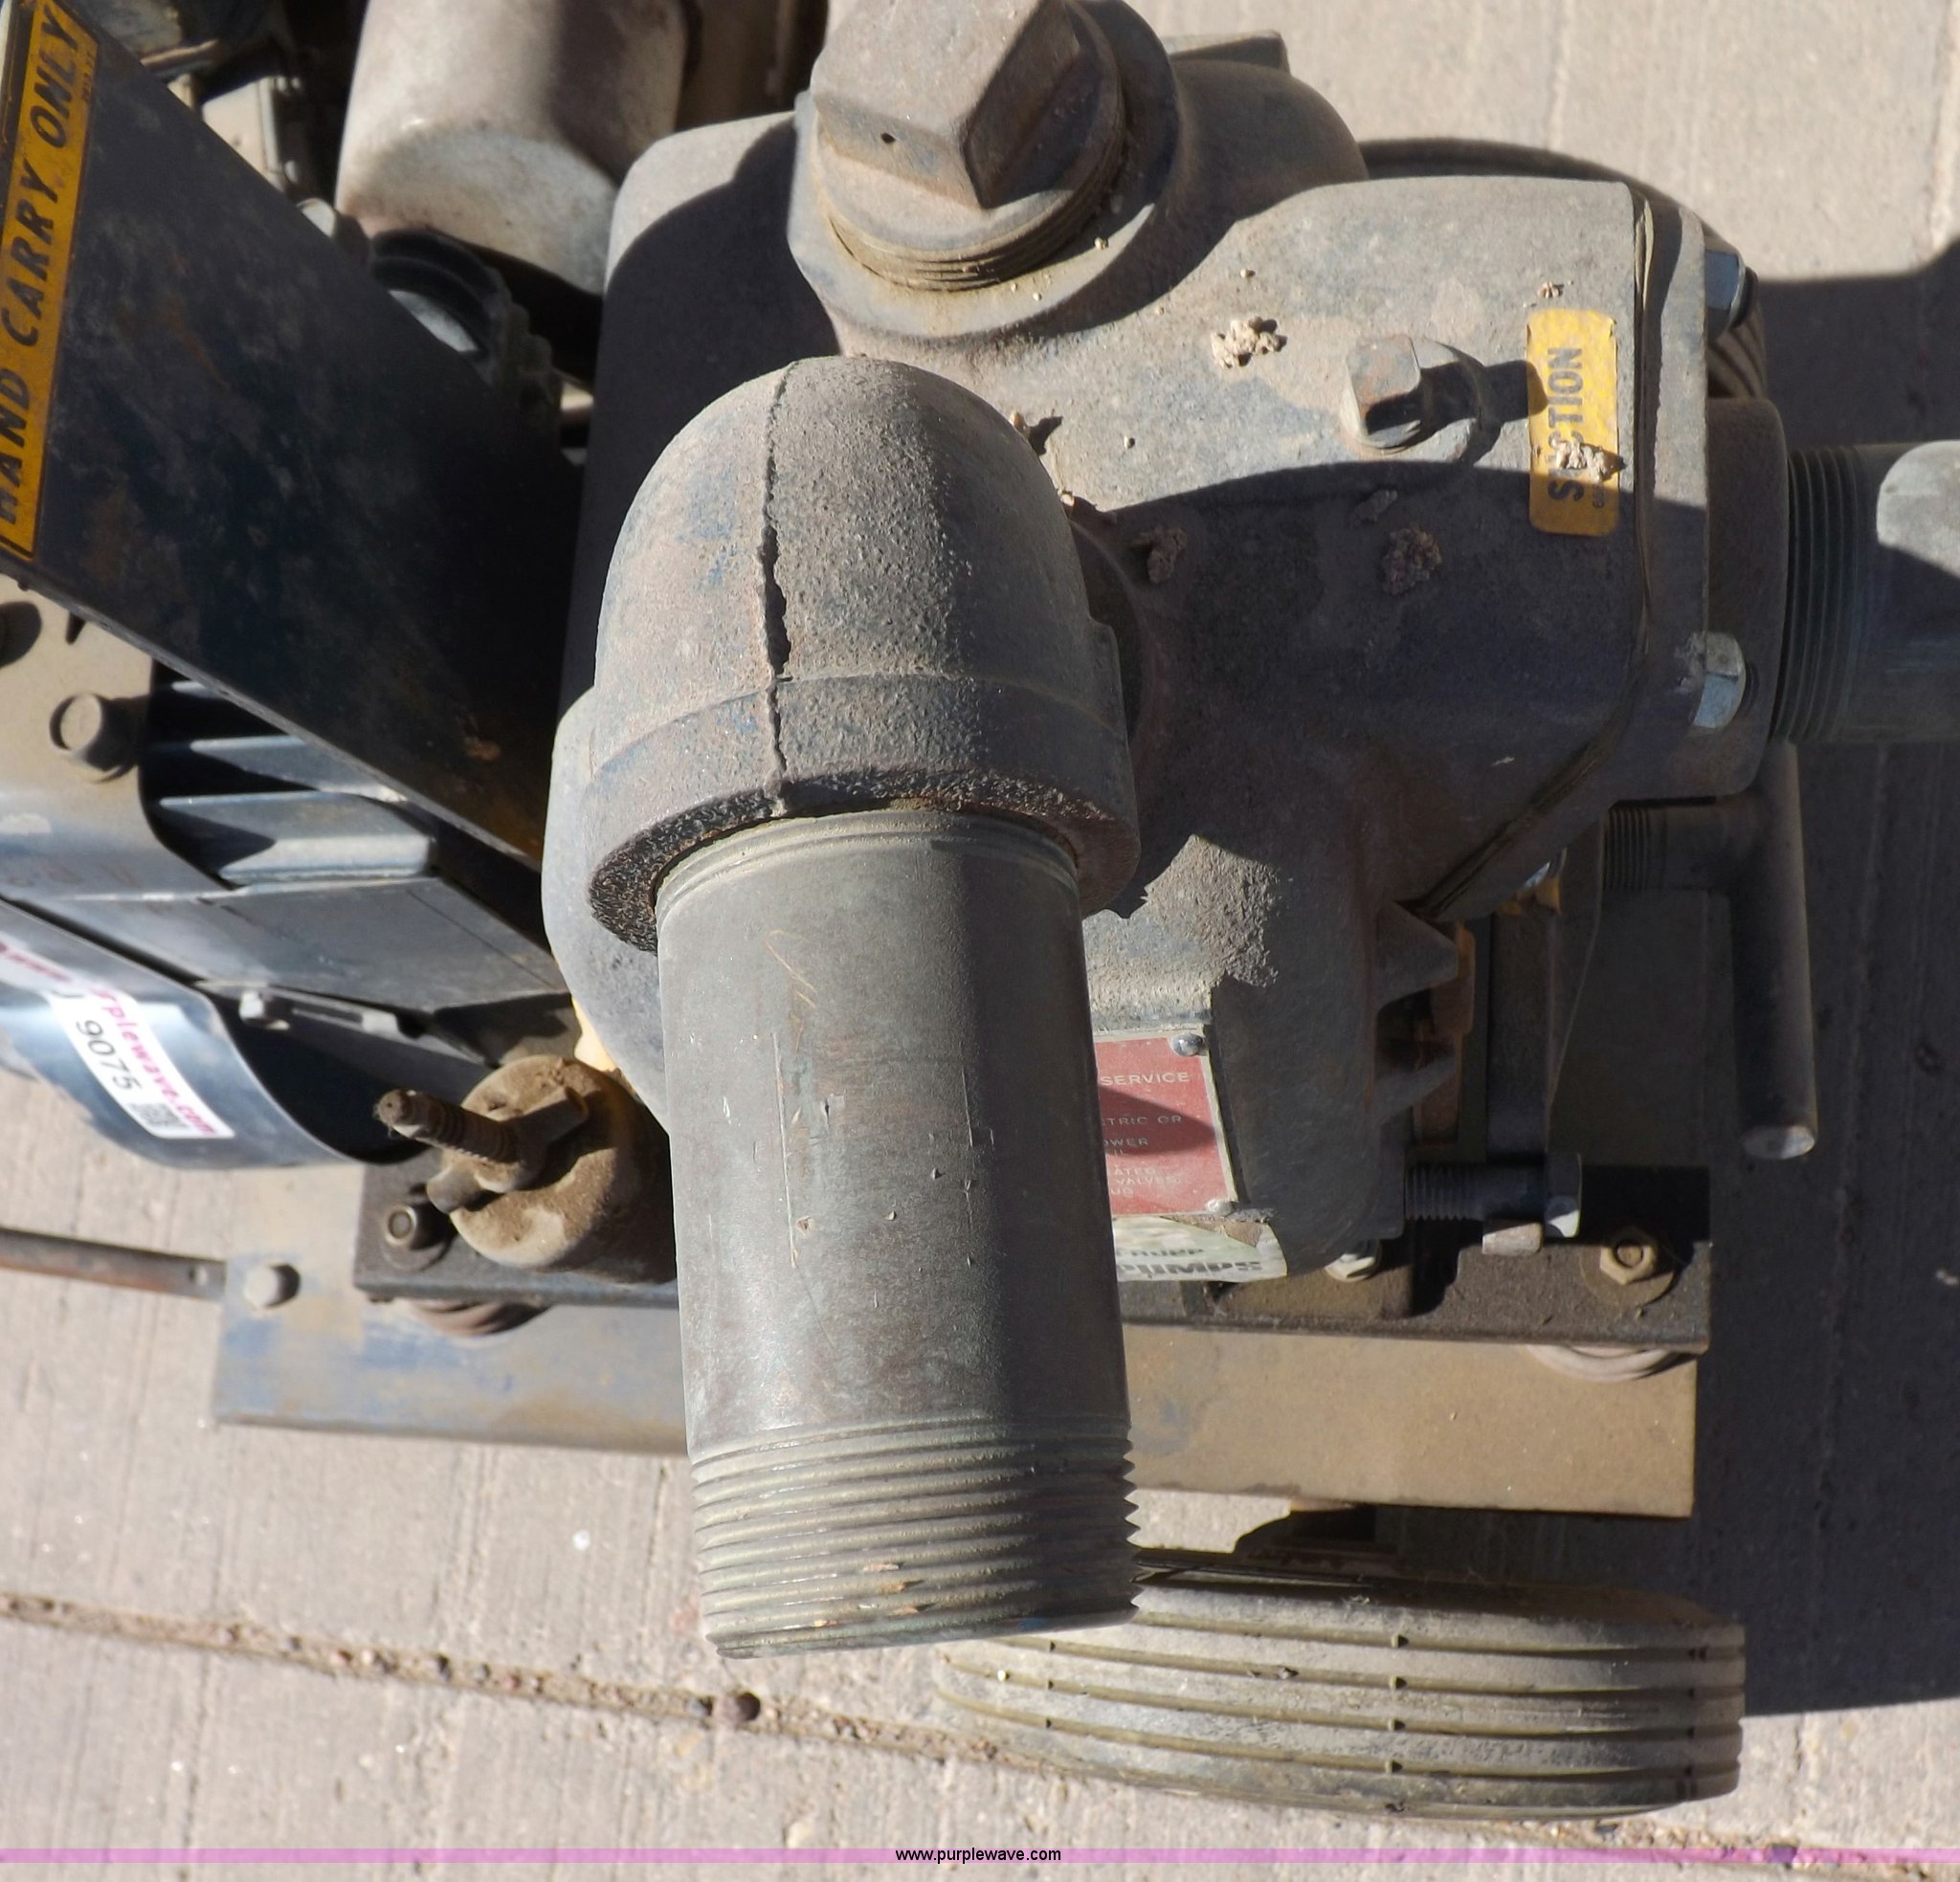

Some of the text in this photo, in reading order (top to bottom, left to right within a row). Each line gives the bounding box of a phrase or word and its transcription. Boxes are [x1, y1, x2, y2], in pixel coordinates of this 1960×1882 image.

[2, 158, 58, 347] CARRY
[30, 5, 78, 148] ONLY
[1101, 1072, 1191, 1086] SERVICE
[1102, 1115, 1182, 1126] TRIC OR
